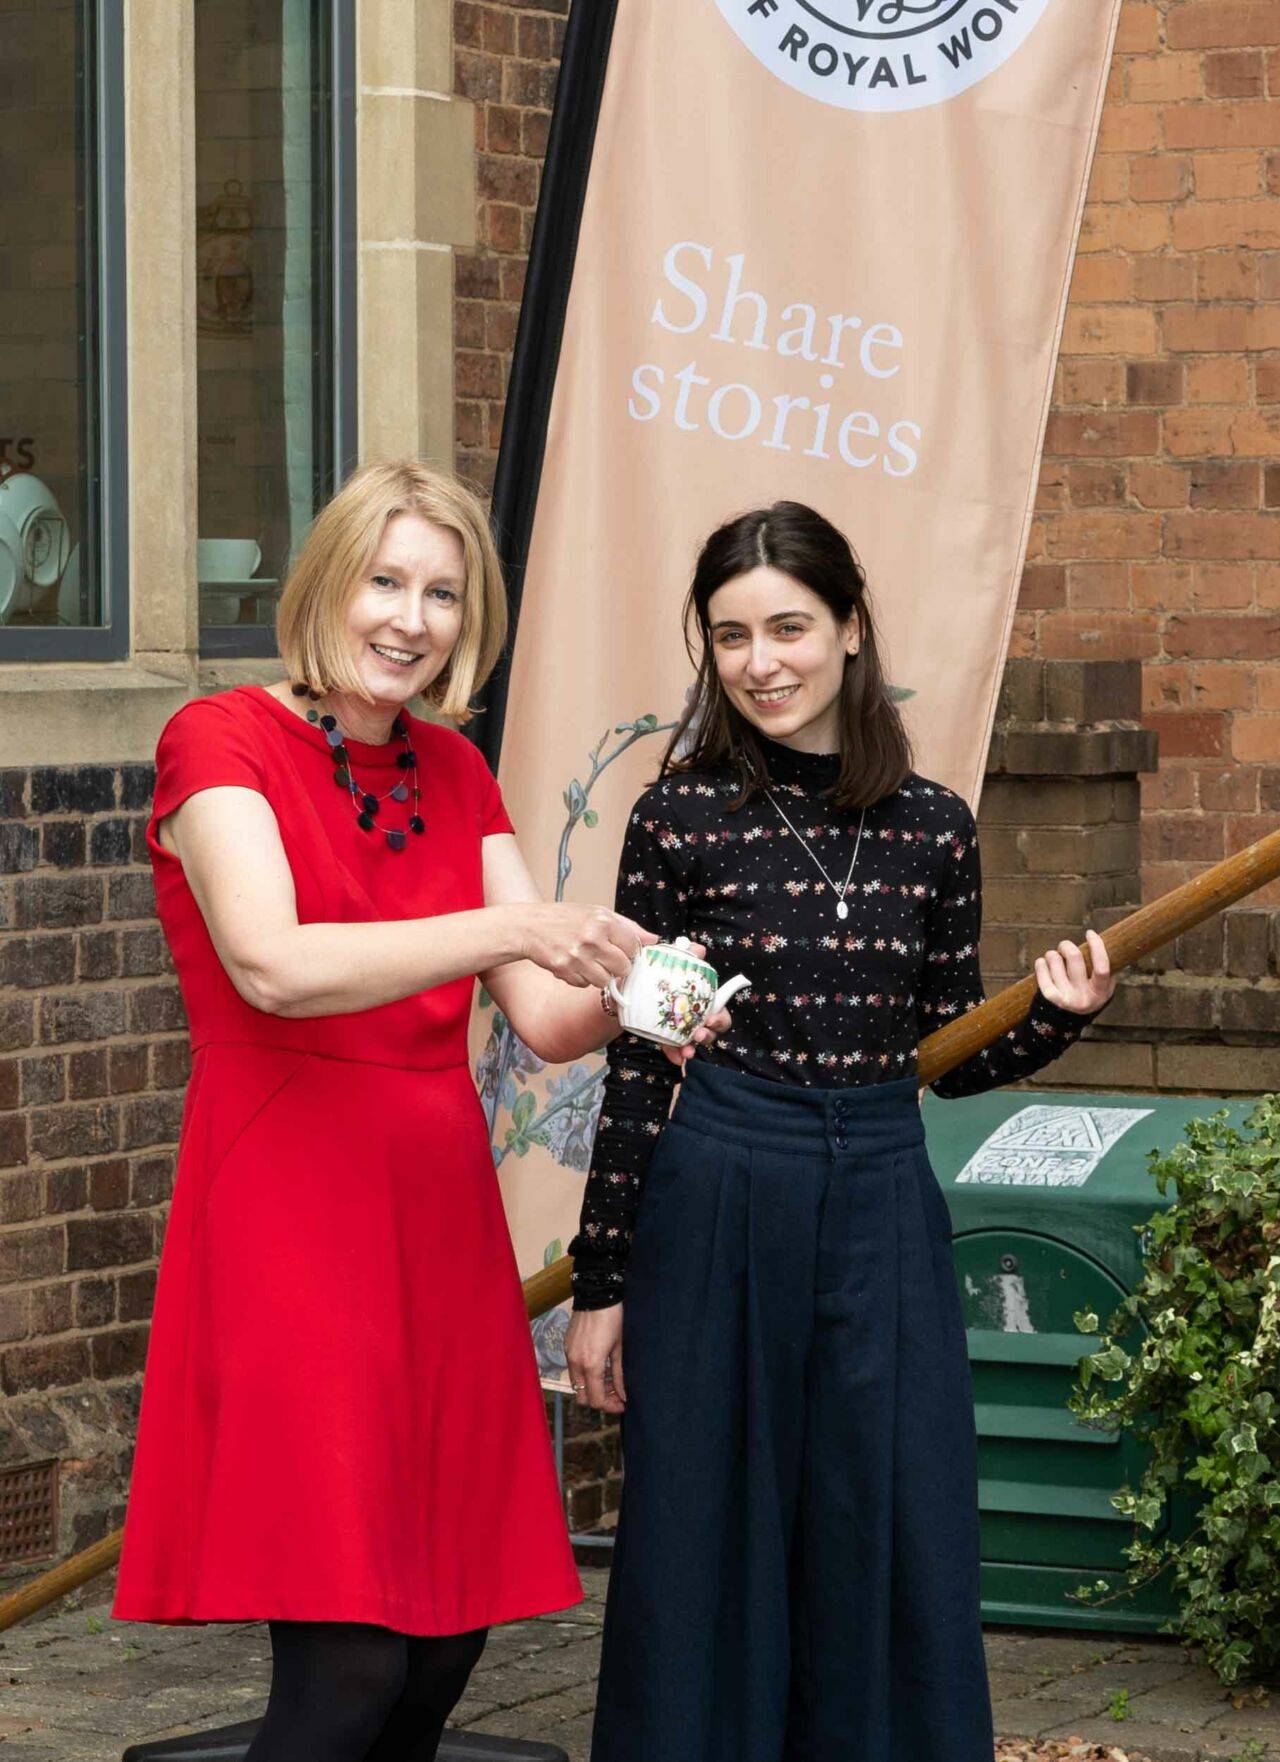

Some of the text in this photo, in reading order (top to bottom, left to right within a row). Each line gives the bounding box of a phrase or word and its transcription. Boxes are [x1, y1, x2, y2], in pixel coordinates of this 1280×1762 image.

[777, 23, 927, 89] ROYAL
[651, 241, 904, 379] Share
[628, 361, 923, 477] stories
